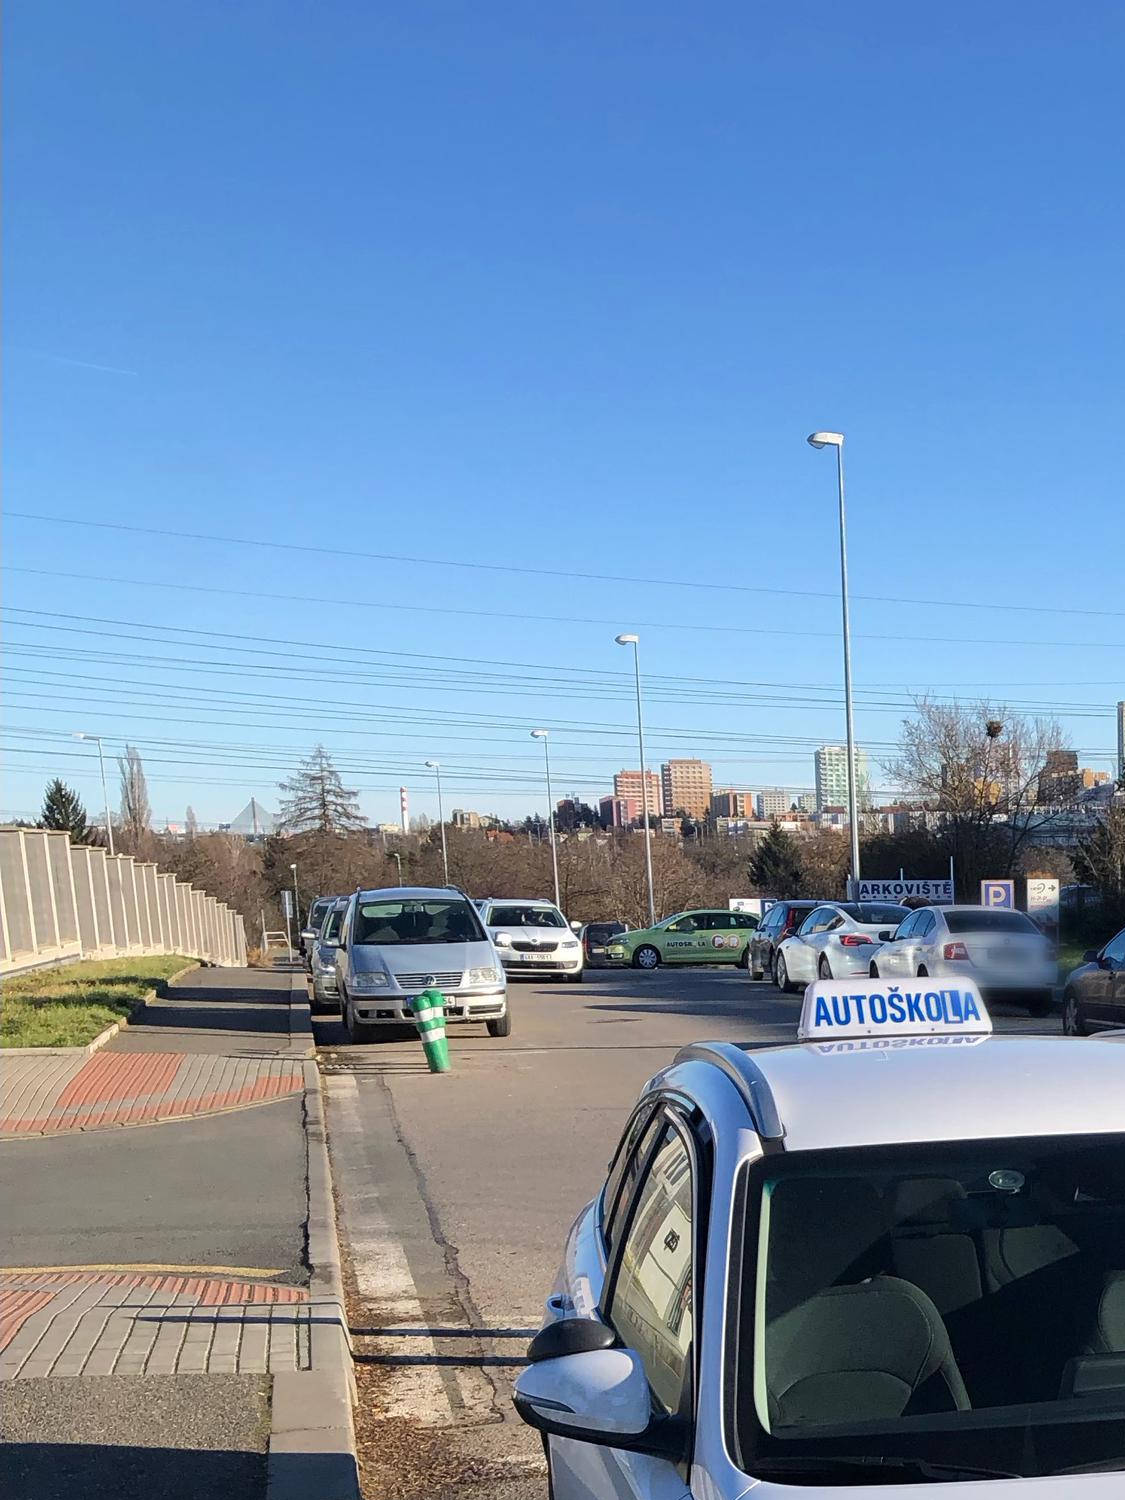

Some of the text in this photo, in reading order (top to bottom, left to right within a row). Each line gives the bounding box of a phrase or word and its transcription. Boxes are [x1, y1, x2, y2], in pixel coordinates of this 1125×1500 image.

[859, 881, 952, 895] ARKOVIŠTĚ
[988, 885, 1007, 908] P
[814, 986, 981, 1028] AUTOŠKOLA
